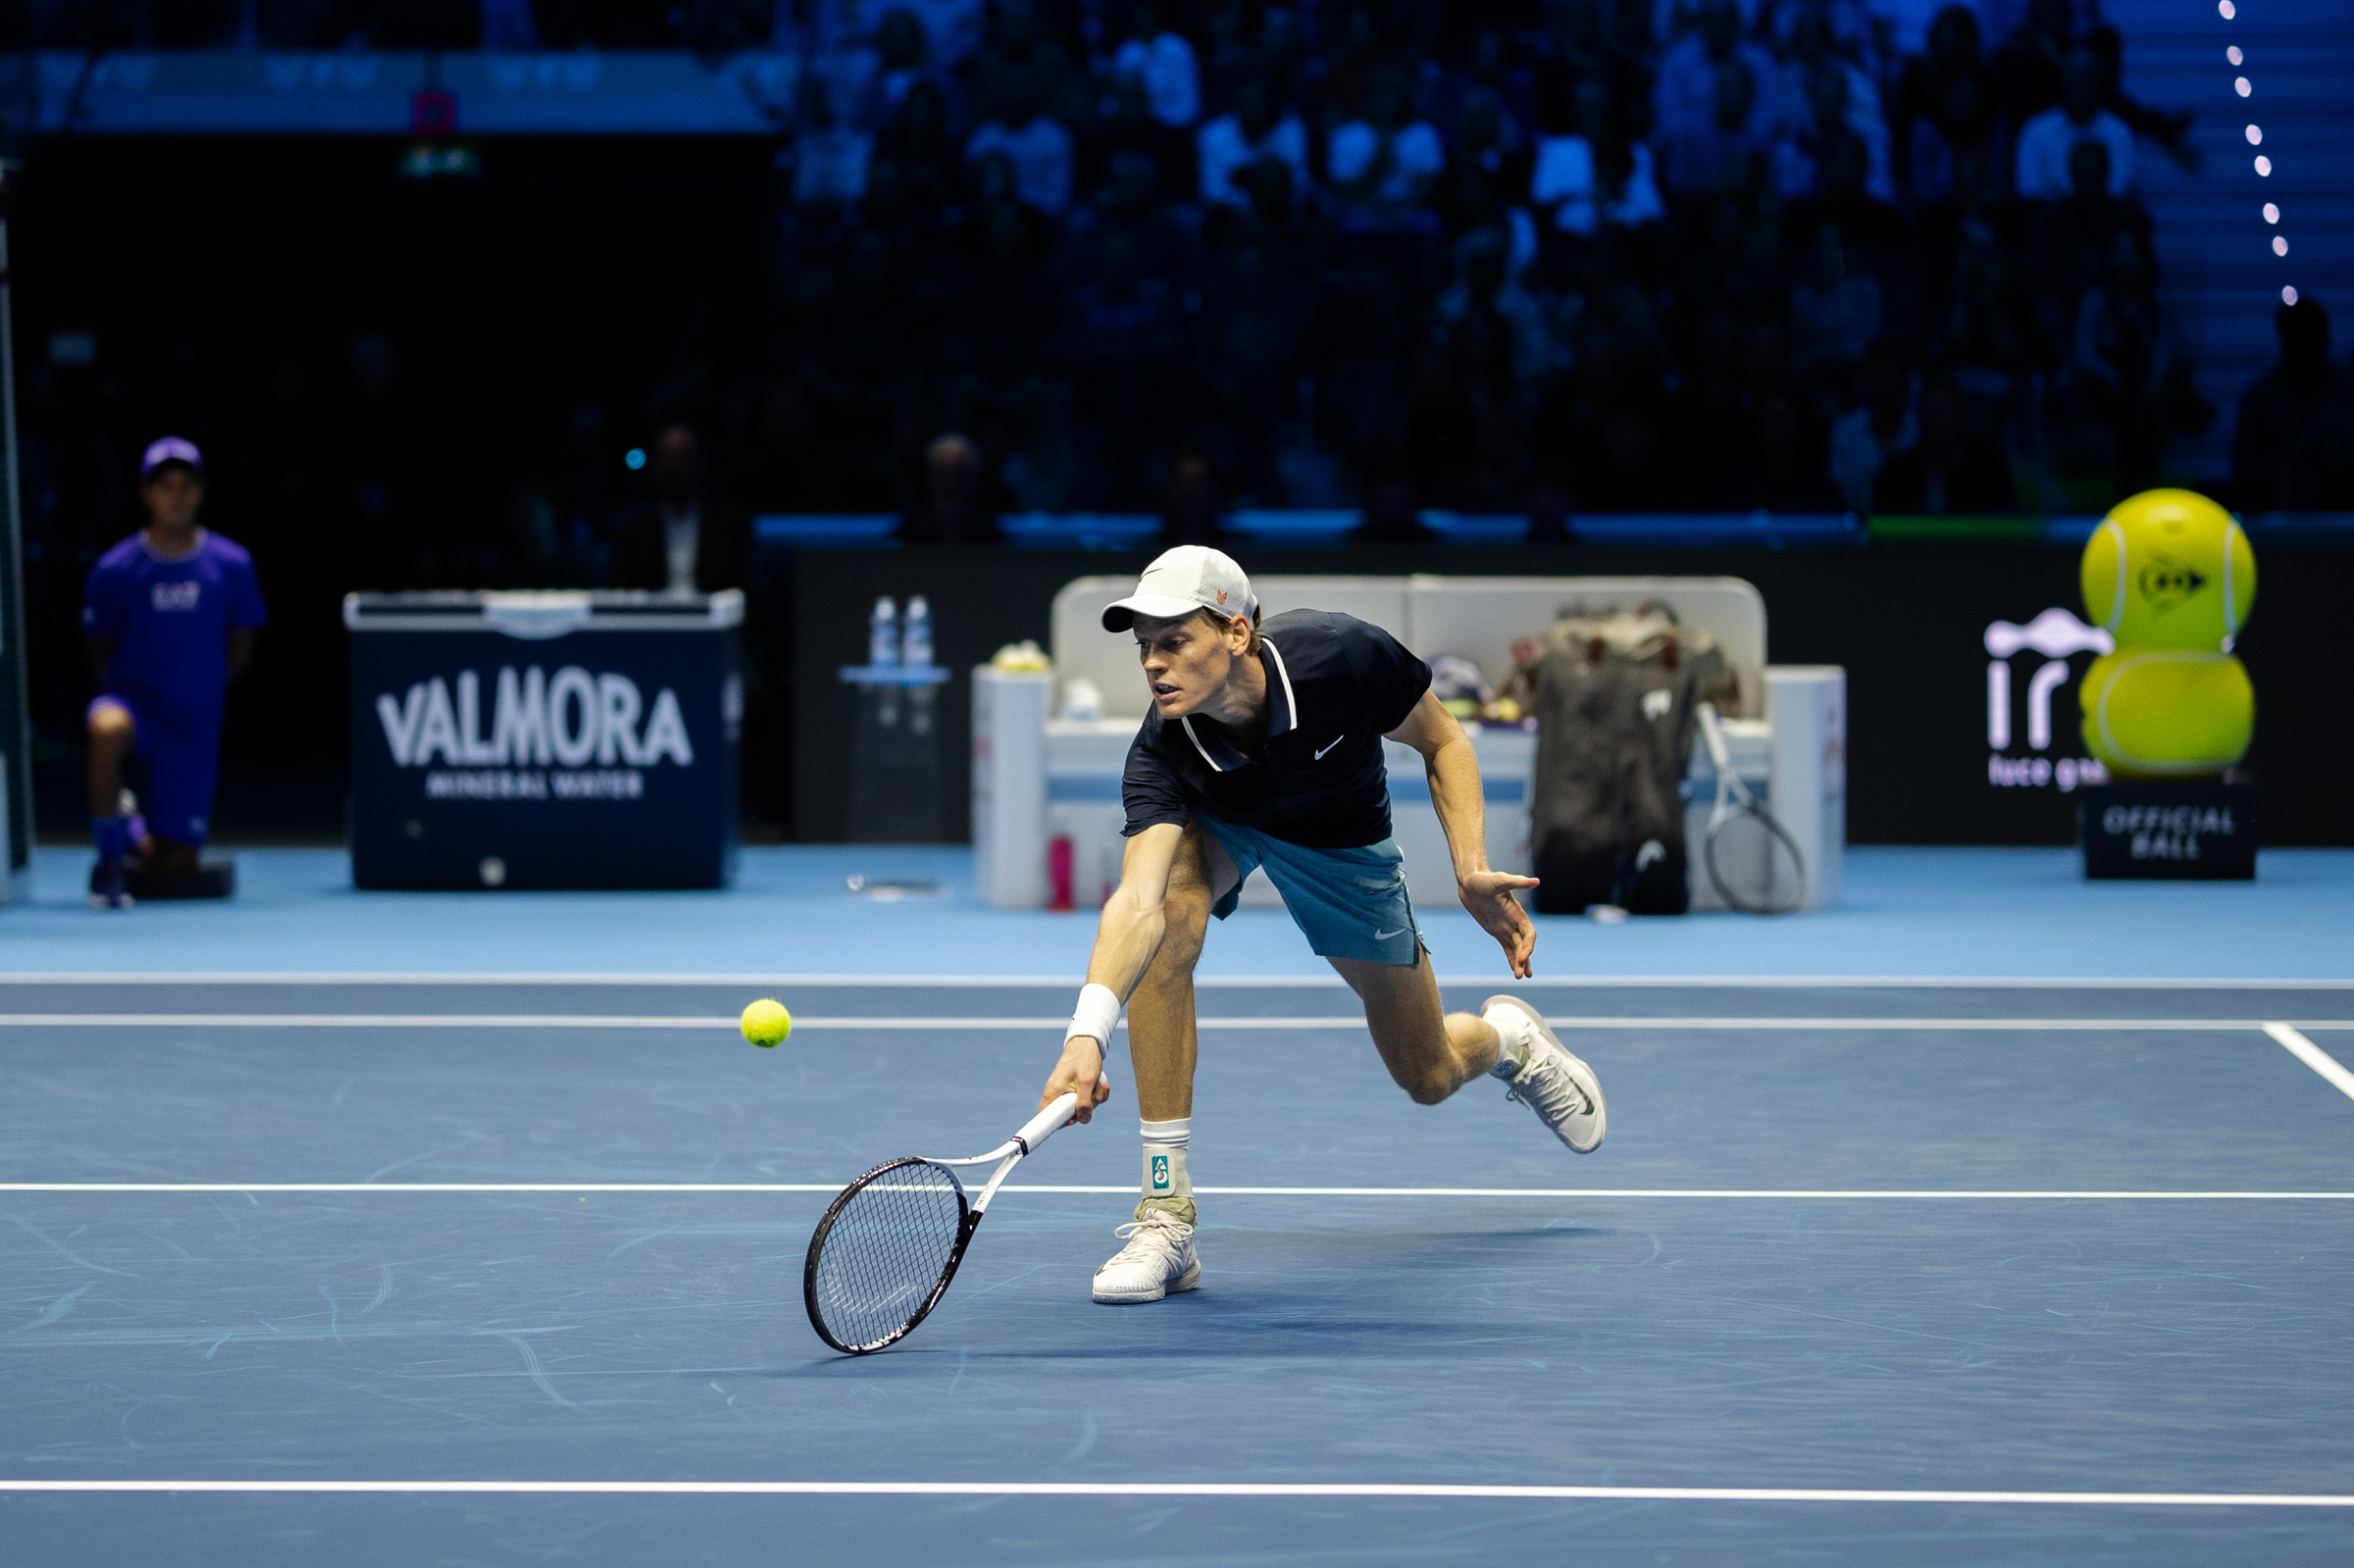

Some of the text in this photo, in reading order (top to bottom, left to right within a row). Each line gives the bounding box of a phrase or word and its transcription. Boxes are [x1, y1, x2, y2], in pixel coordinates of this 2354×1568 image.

[377, 666, 693, 765] VALMORA
[2103, 806, 2236, 835] OFFICIAL
[2131, 834, 2201, 859] BALL
